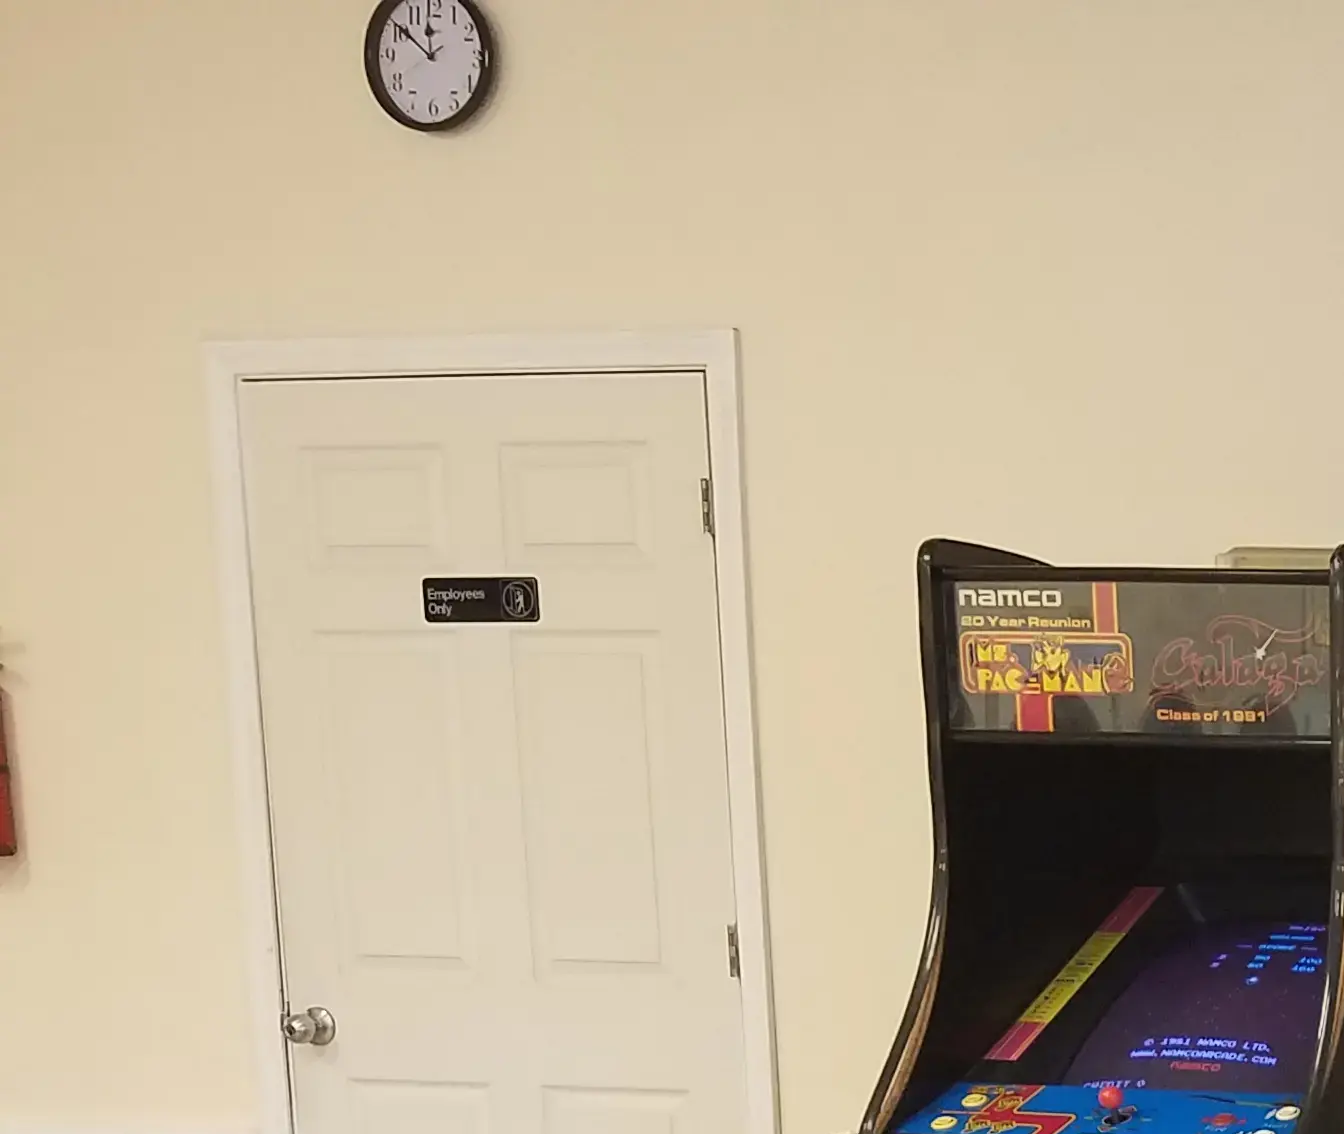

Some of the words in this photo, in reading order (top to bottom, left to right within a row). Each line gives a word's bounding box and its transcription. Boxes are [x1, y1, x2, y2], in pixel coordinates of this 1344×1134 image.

[427, 588, 485, 602] Employees
[958, 588, 1063, 608] namco
[428, 603, 452, 617] Only
[985, 615, 1026, 628] Year
[1028, 616, 1092, 628] Reunion
[976, 668, 1104, 693] PAC-MAN
[1156, 708, 1200, 722] Class
[1203, 708, 1219, 722] of
[1197, 1037, 1238, 1049] NAMCO
[1243, 1041, 1271, 1052] LTD.
